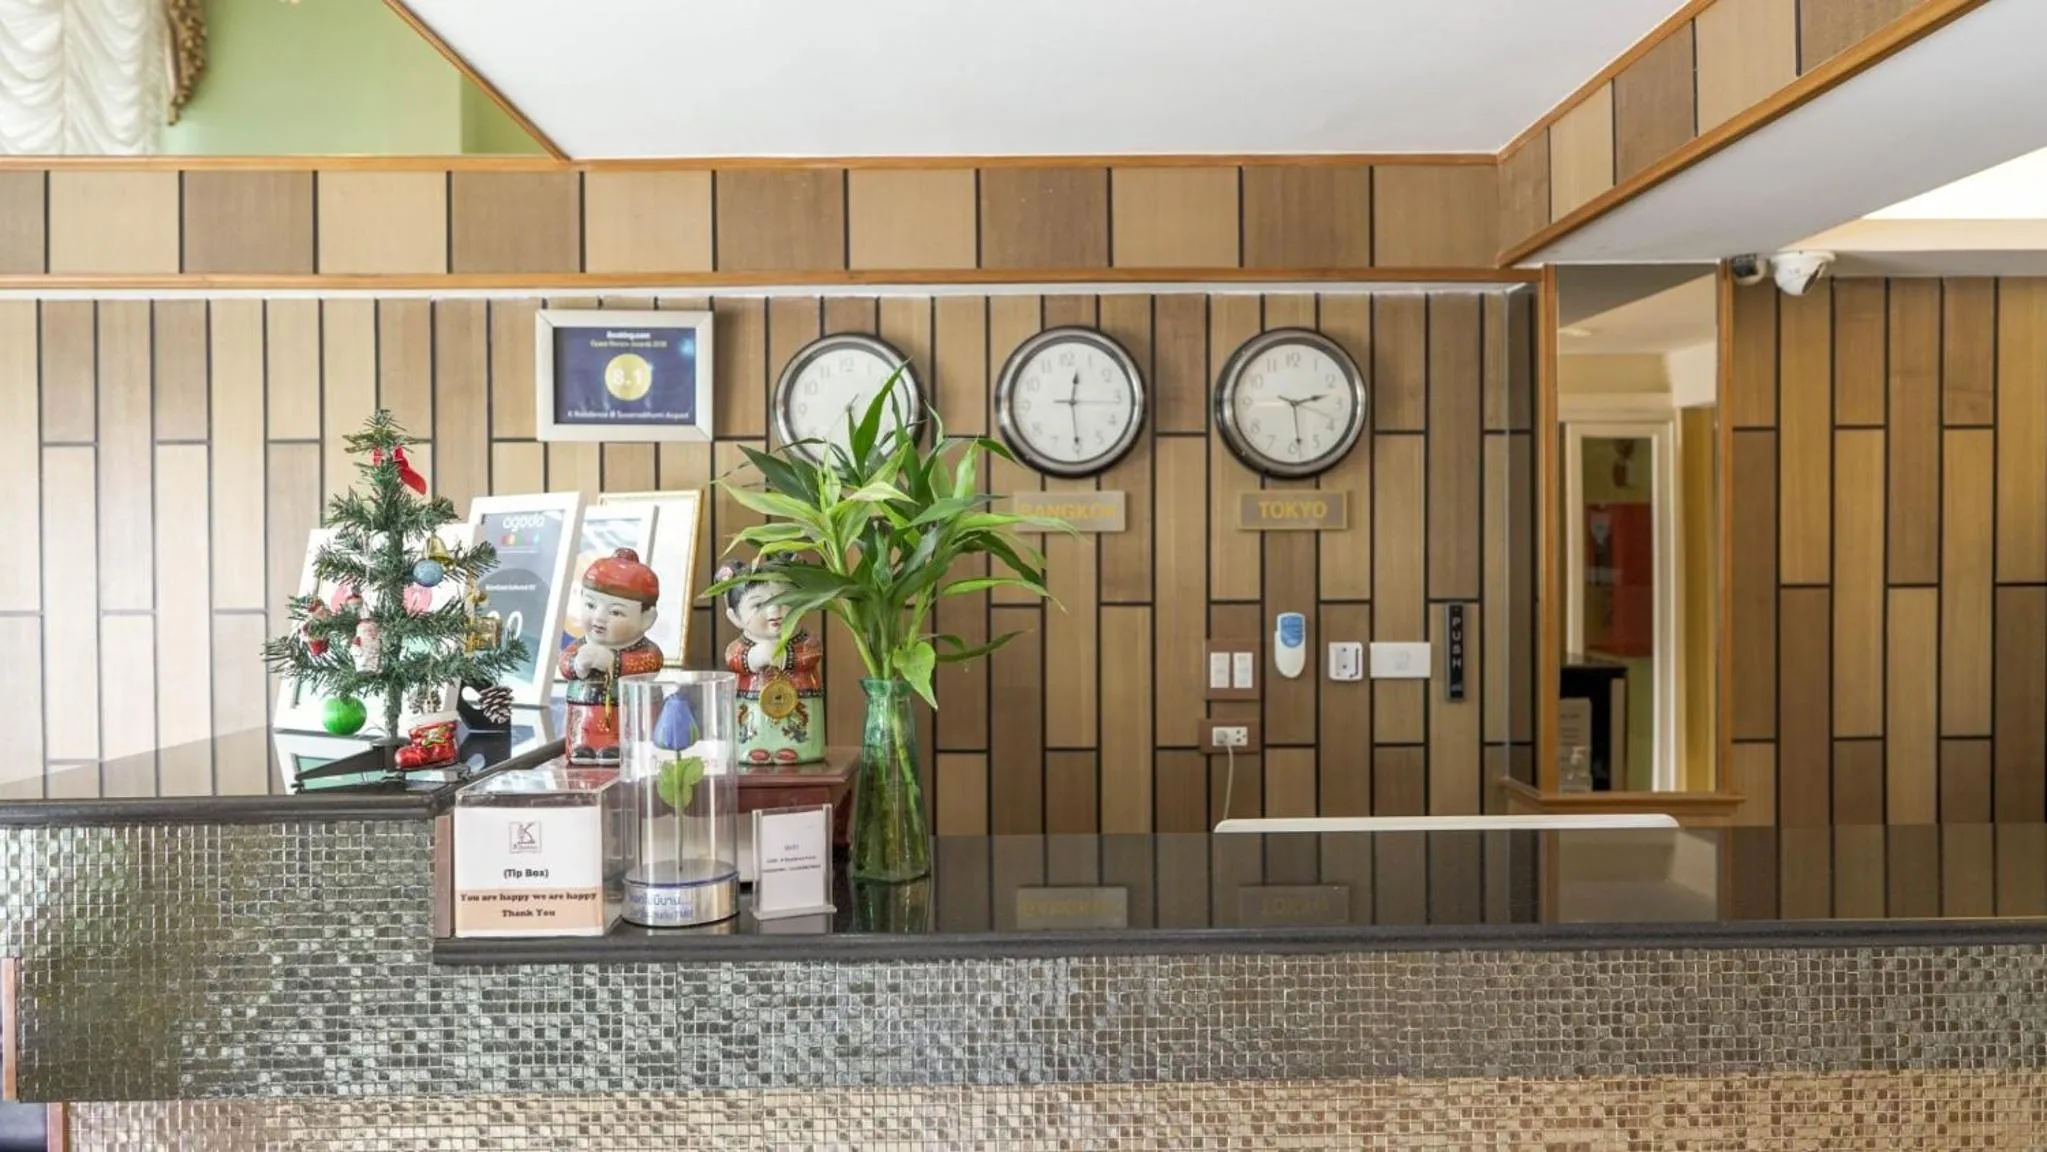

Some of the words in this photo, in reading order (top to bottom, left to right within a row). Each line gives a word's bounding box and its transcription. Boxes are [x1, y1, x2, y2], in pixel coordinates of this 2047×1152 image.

[1258, 501, 1328, 519] TOKYO
[1452, 616, 1462, 669] PUSH
[503, 868, 522, 880] (Tip
[525, 868, 549, 879] Box)
[460, 893, 480, 902] You
[481, 894, 497, 902] are
[499, 892, 529, 903] happy
[532, 893, 547, 901] we
[548, 892, 564, 900] are
[566, 891, 597, 902] happy
[502, 908, 533, 918] Thank
[536, 907, 556, 917] You
